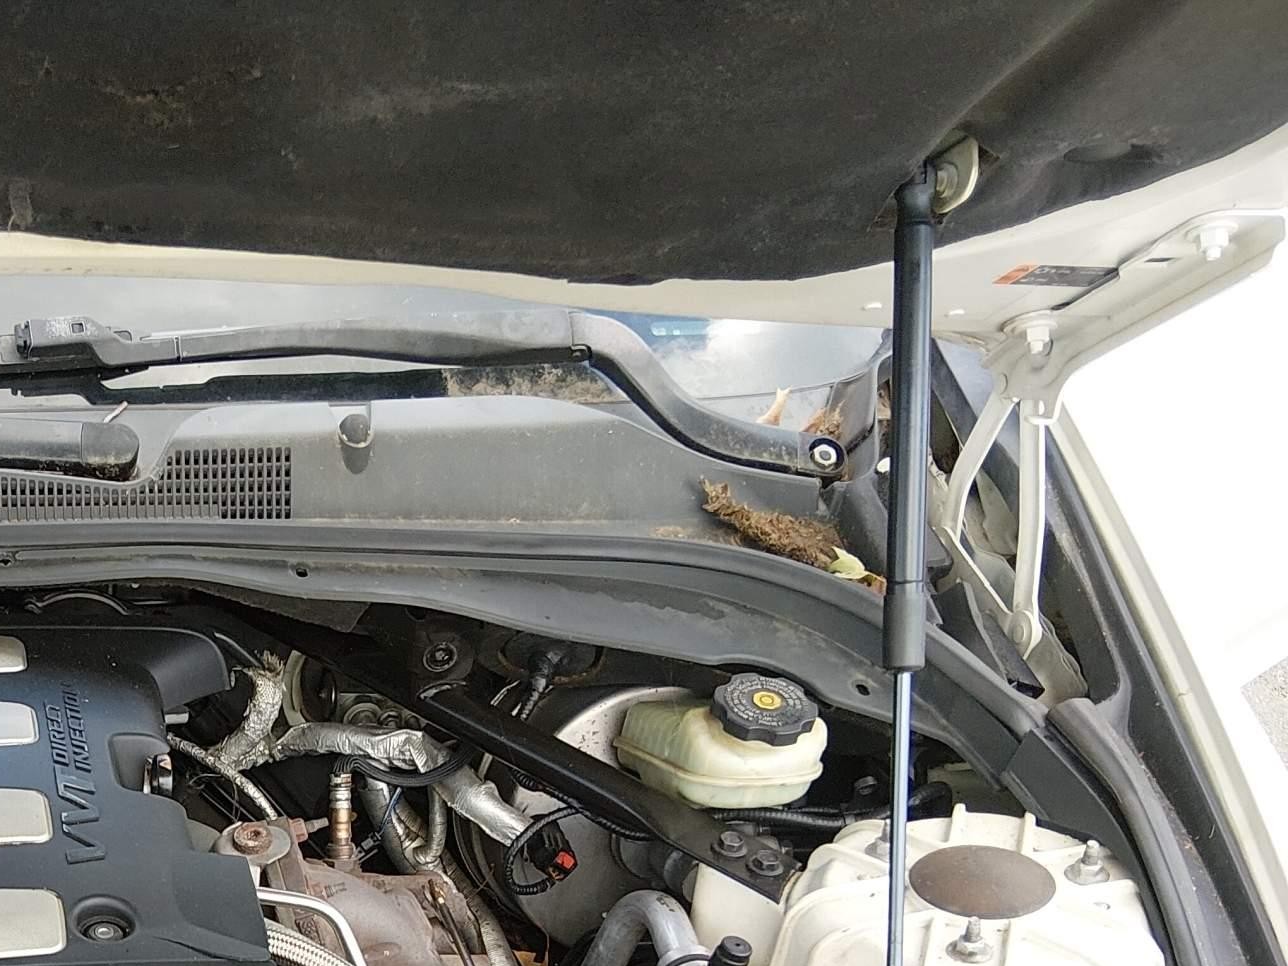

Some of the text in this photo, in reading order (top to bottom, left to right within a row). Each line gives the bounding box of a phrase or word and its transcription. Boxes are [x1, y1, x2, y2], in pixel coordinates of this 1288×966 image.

[44, 700, 69, 766] DIRECT
[62, 681, 92, 773] INJECTION
[54, 765, 105, 864] VVT
